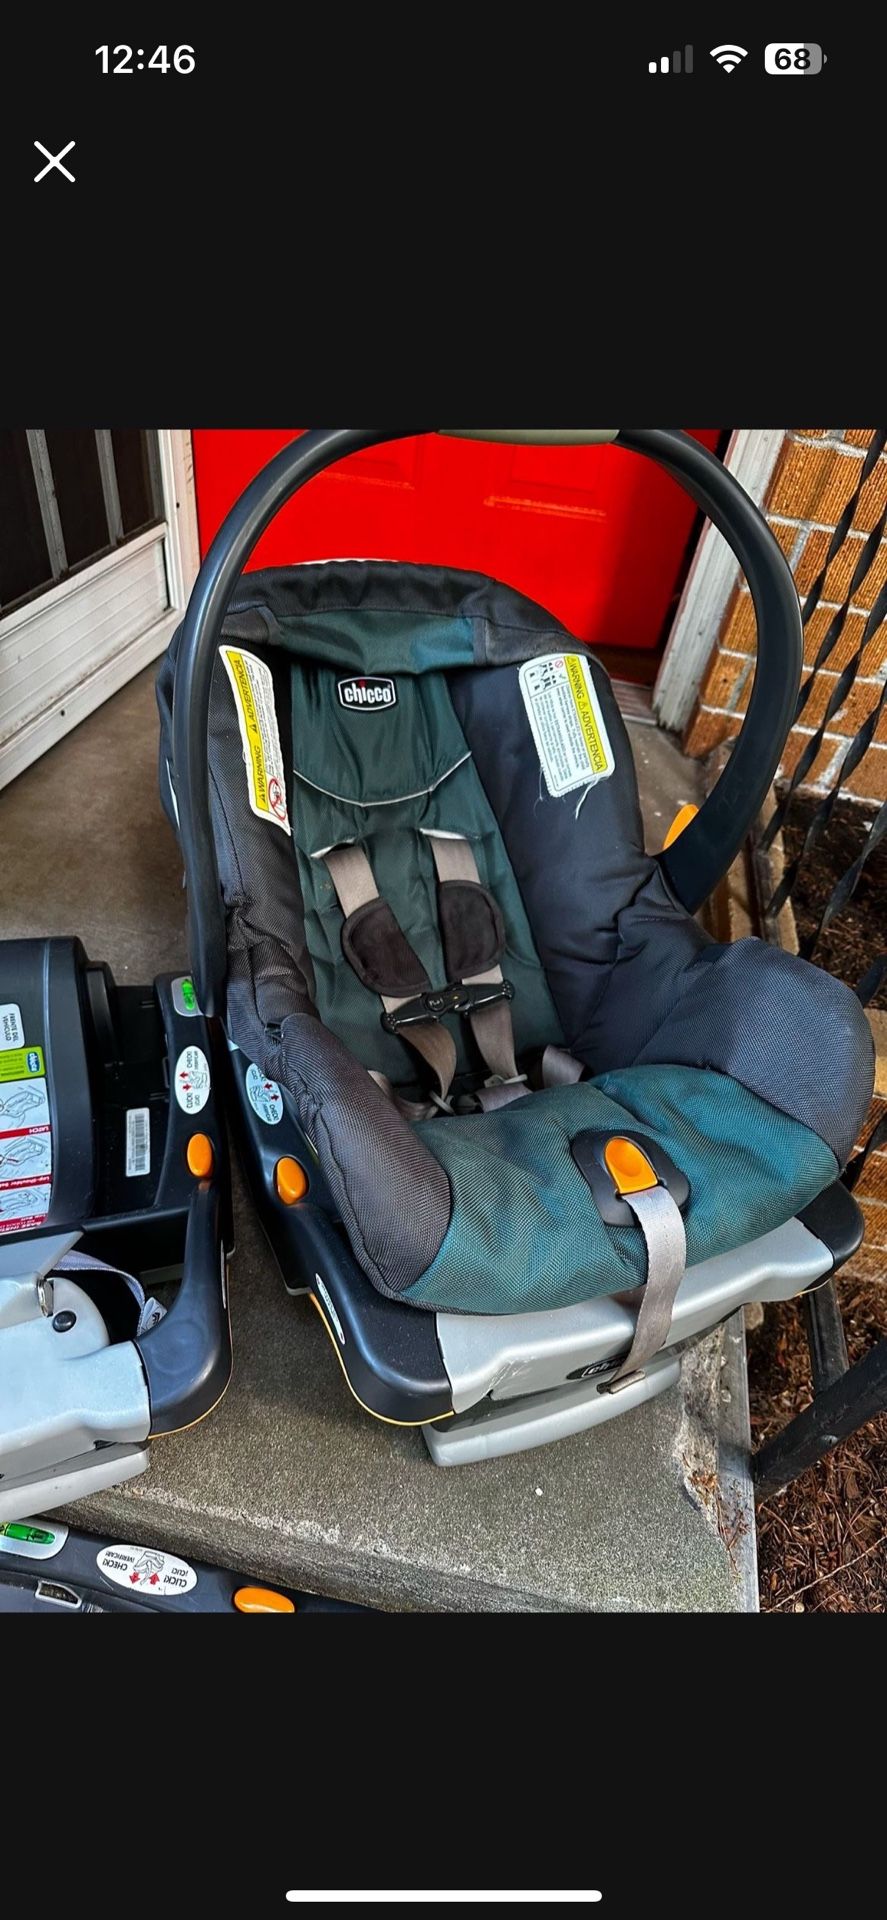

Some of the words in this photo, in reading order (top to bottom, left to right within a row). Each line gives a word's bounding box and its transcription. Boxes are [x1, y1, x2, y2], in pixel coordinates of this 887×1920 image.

[234, 659, 257, 722] ADVERTENCIA
[344, 681, 392, 704] chicco
[570, 662, 585, 700] WARNING
[582, 711, 604, 771] ADVERTENCIA
[255, 745, 266, 796] WARNING
[102, 1558, 128, 1571] CHECK!
[164, 1575, 187, 1588] CLICK!
